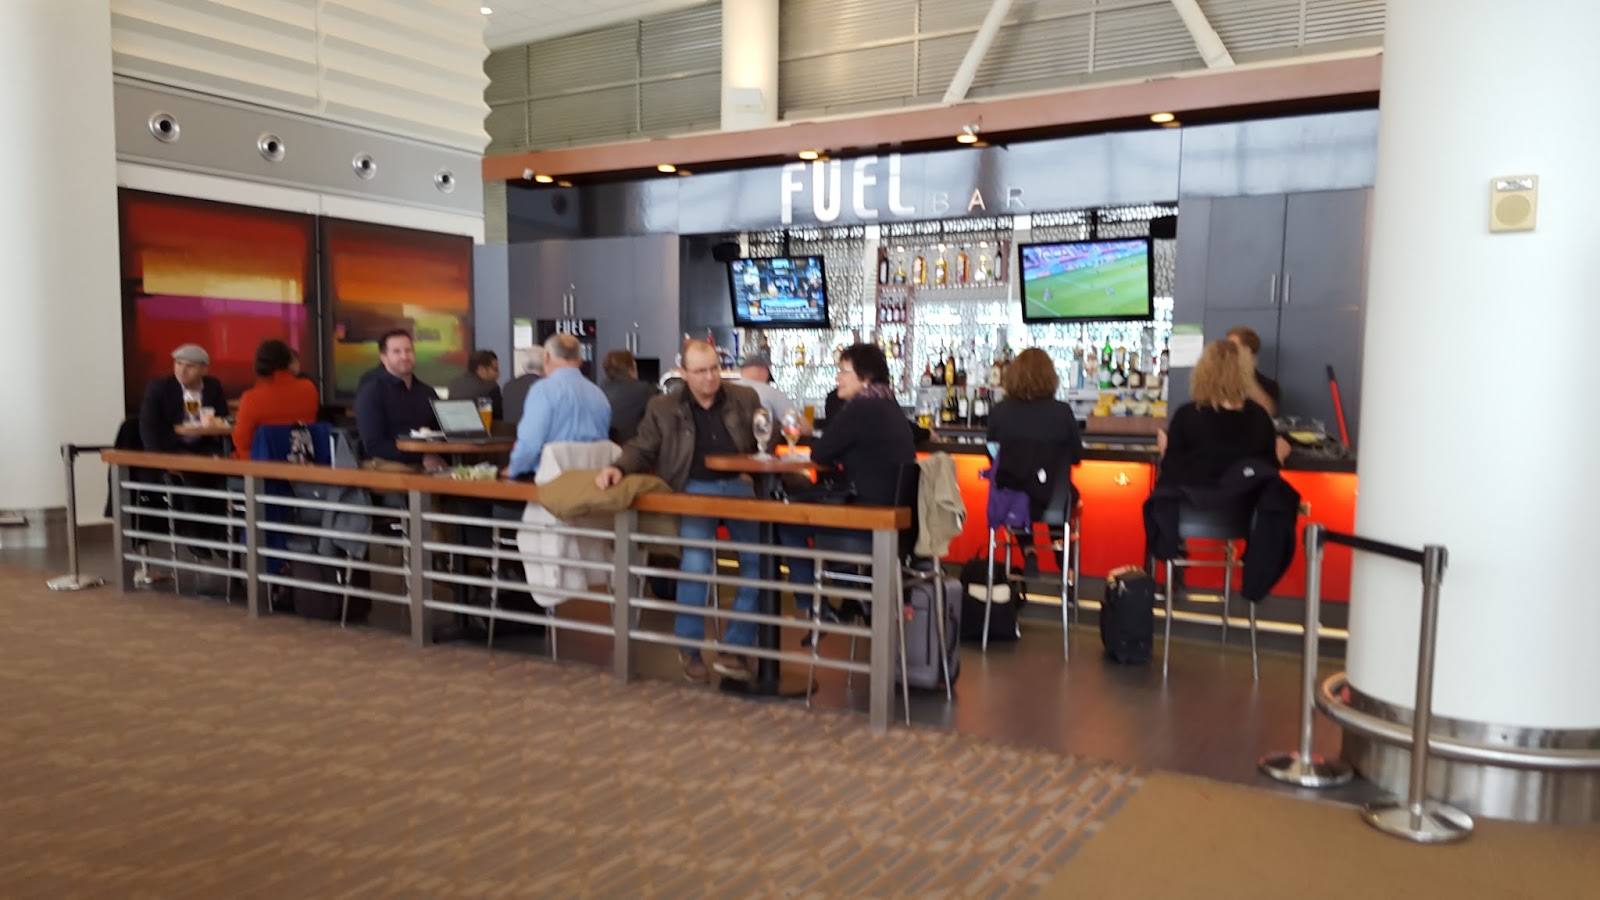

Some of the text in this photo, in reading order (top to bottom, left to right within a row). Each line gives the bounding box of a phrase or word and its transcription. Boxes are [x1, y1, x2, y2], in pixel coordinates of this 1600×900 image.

[780, 153, 1025, 224] FUEL BAR
[556, 319, 586, 336] FUEL
